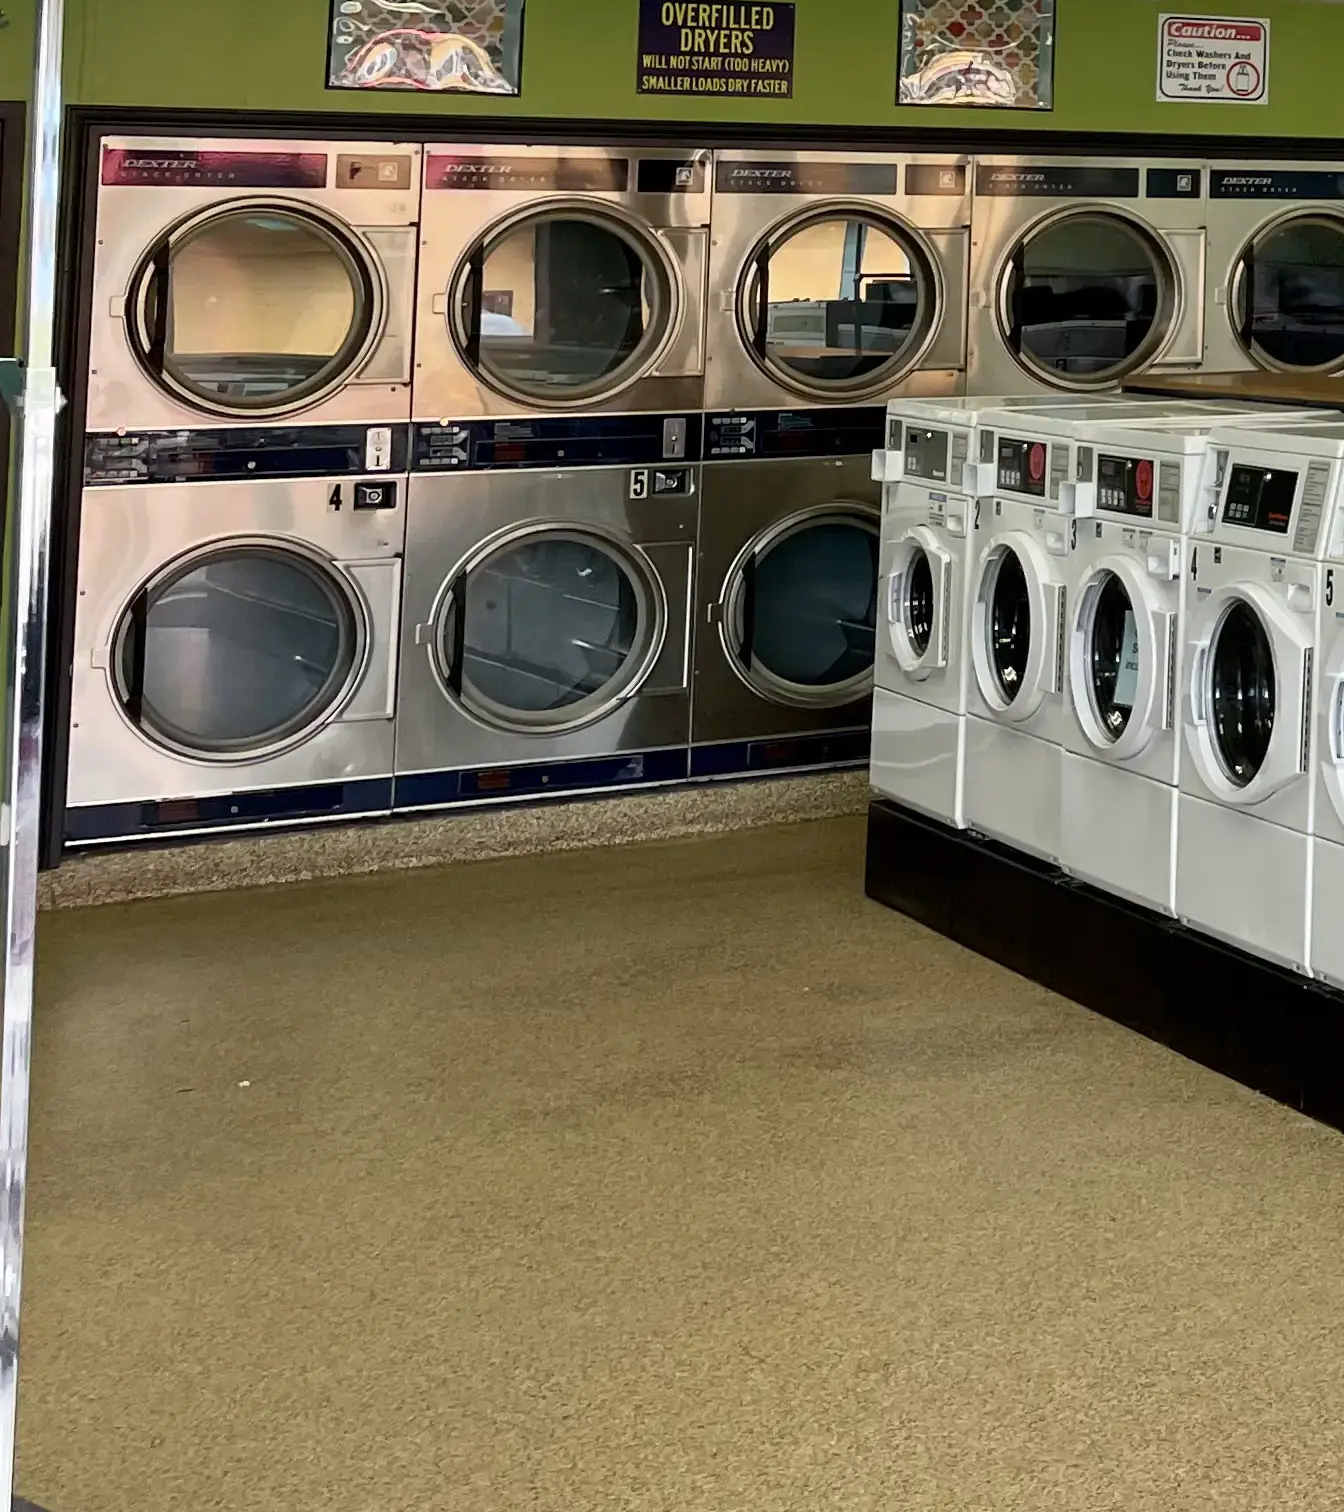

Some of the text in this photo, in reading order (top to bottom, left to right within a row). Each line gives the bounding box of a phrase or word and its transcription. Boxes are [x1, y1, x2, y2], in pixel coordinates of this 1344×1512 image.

[662, 2, 774, 30] OVERFILLED
[680, 28, 754, 54] DRYERS
[1167, 49, 1251, 60] Check Washers And
[642, 55, 789, 73] WILL NOT START (TOO HEAVY)
[1166, 60, 1226, 70] Dryers Before
[642, 76, 788, 94] SMALLER LOADS DRY FASTER
[1166, 71, 1216, 81] Using Them
[122, 160, 197, 168] DEXTER
[445, 164, 513, 173] DEXTER
[731, 169, 792, 178] DEXTER
[1222, 177, 1272, 185] DEXTER
[633, 472, 645, 496] 5
[328, 484, 343, 511] 4
[974, 499, 980, 530] 2
[1071, 519, 1077, 550] 3
[1190, 547, 1198, 581] 4
[1326, 569, 1334, 607] 5
